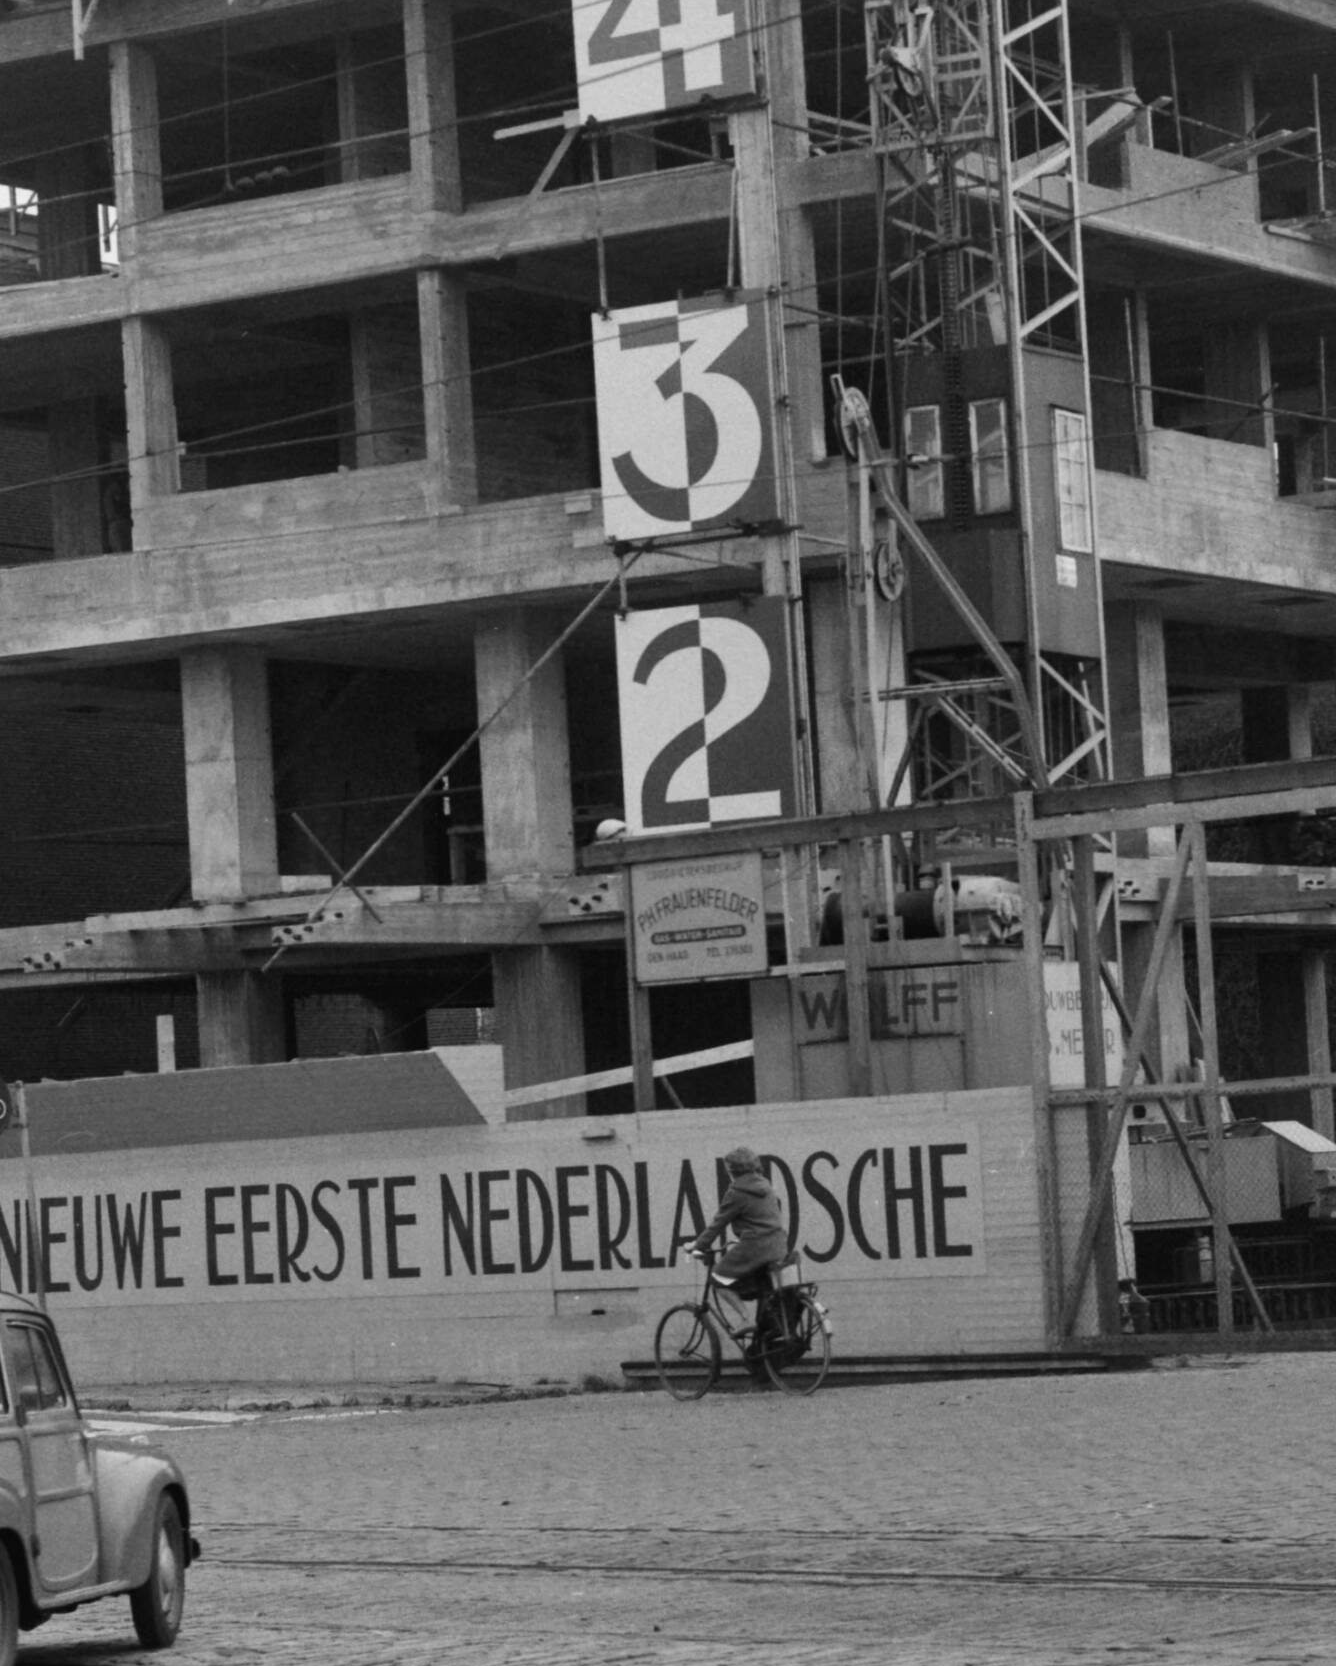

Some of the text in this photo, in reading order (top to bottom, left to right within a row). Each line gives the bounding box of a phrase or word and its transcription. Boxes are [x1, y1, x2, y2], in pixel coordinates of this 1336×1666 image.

[611, 304, 762, 522] 3
[632, 615, 782, 829] 2
[800, 981, 958, 1030] WLFF
[204, 1175, 422, 1287] EERSTE
